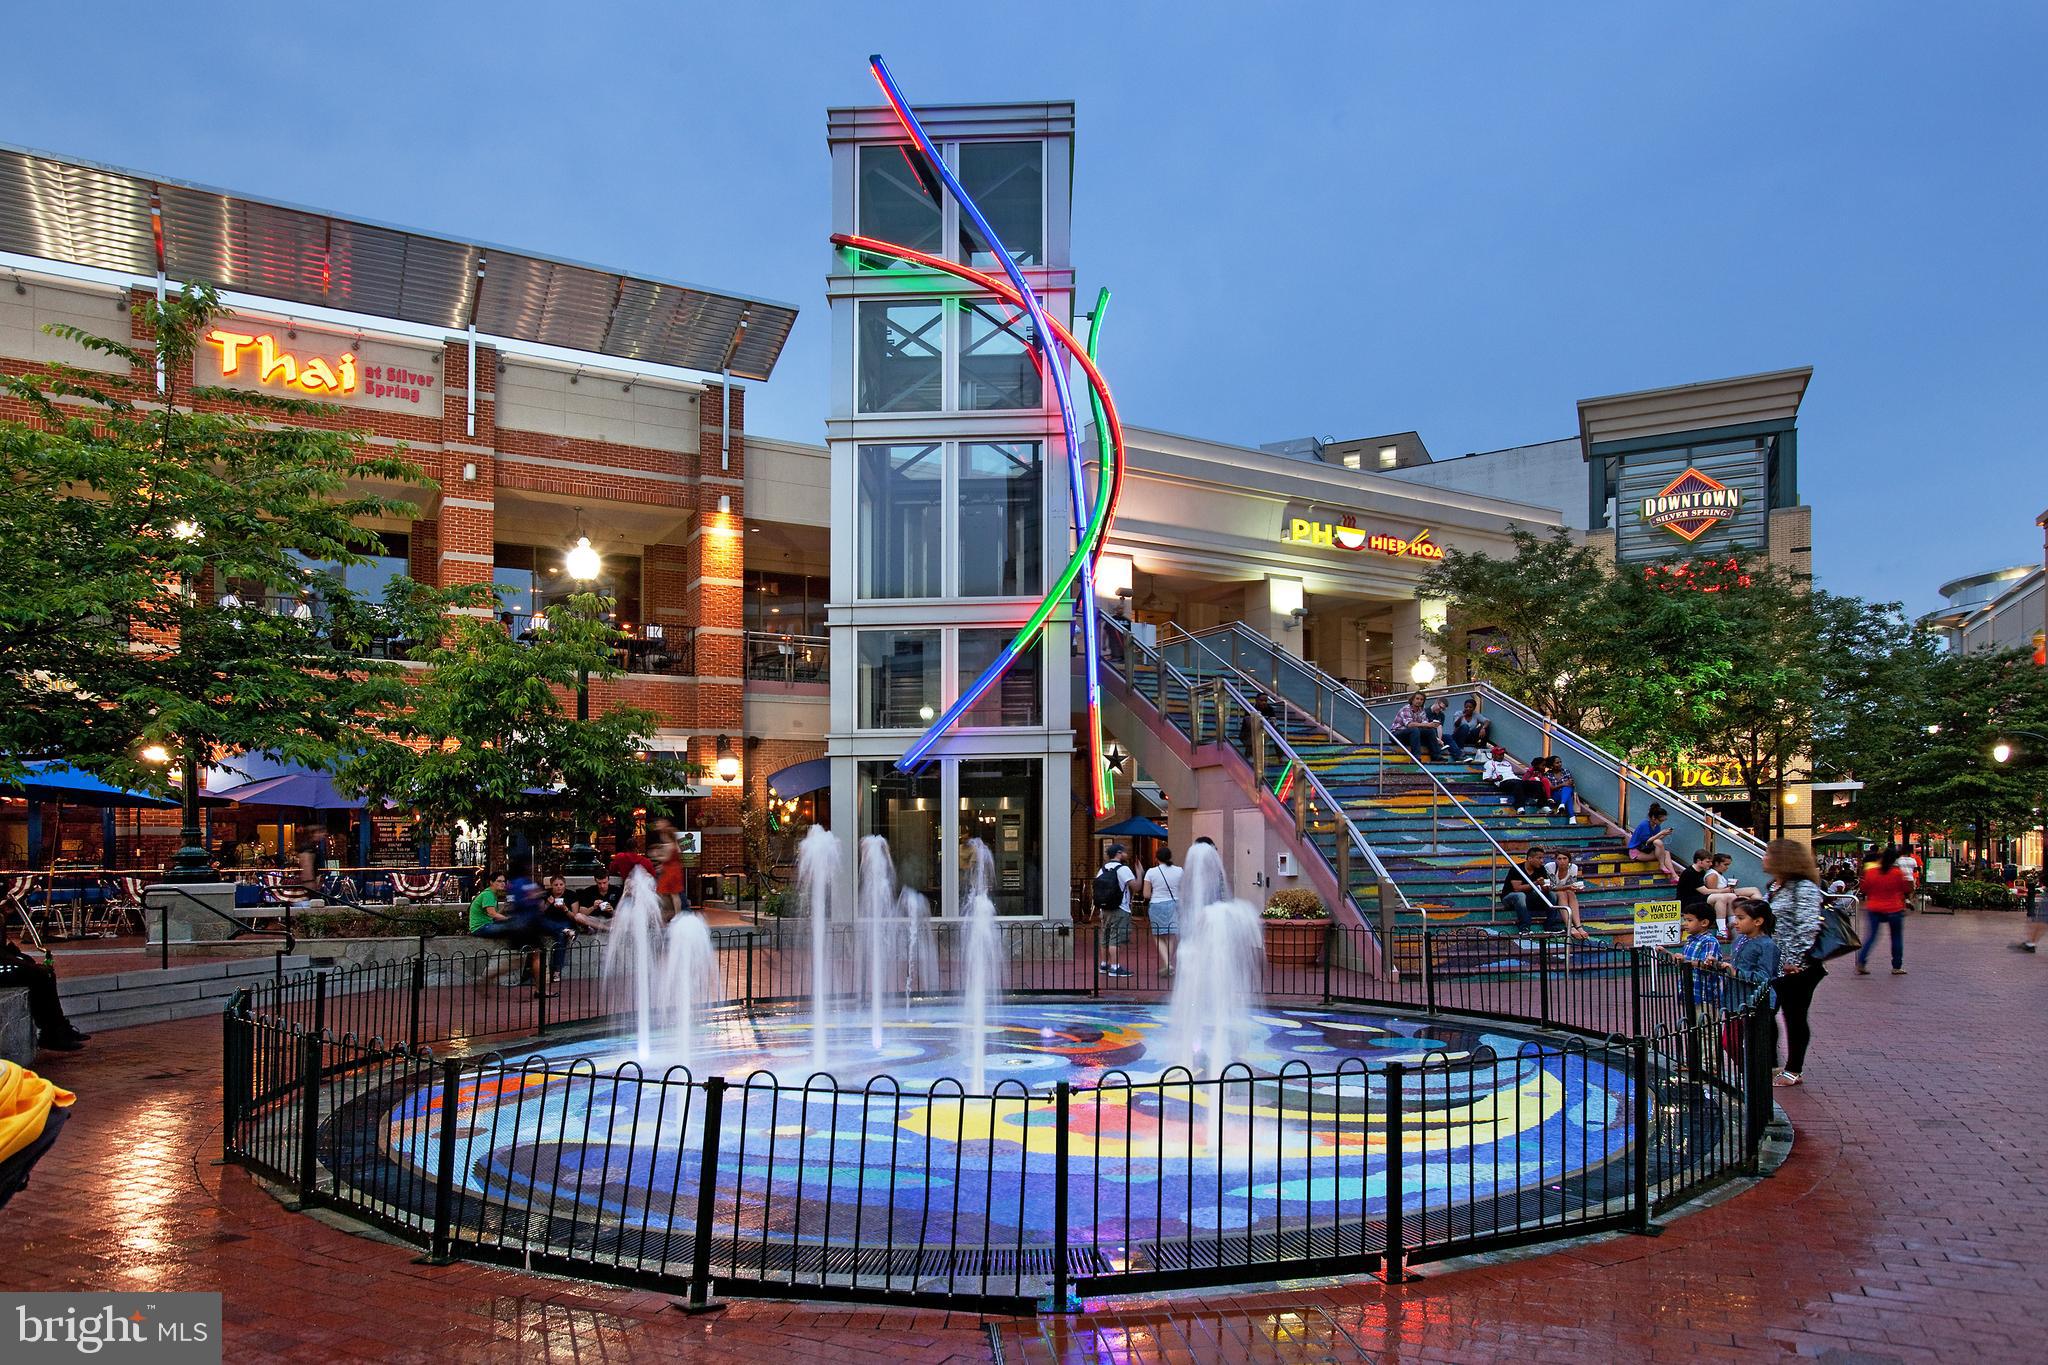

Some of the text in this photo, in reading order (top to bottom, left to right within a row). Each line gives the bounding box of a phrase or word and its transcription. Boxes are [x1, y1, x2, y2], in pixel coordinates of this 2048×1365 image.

[205, 329, 357, 394] Thai
[365, 366, 434, 387] at Silver
[365, 381, 420, 403] Spring
[1645, 489, 1738, 516] DOWNTOWN
[1655, 509, 1727, 523] SILVER SPRING
[1650, 904, 1677, 912] WATCH
